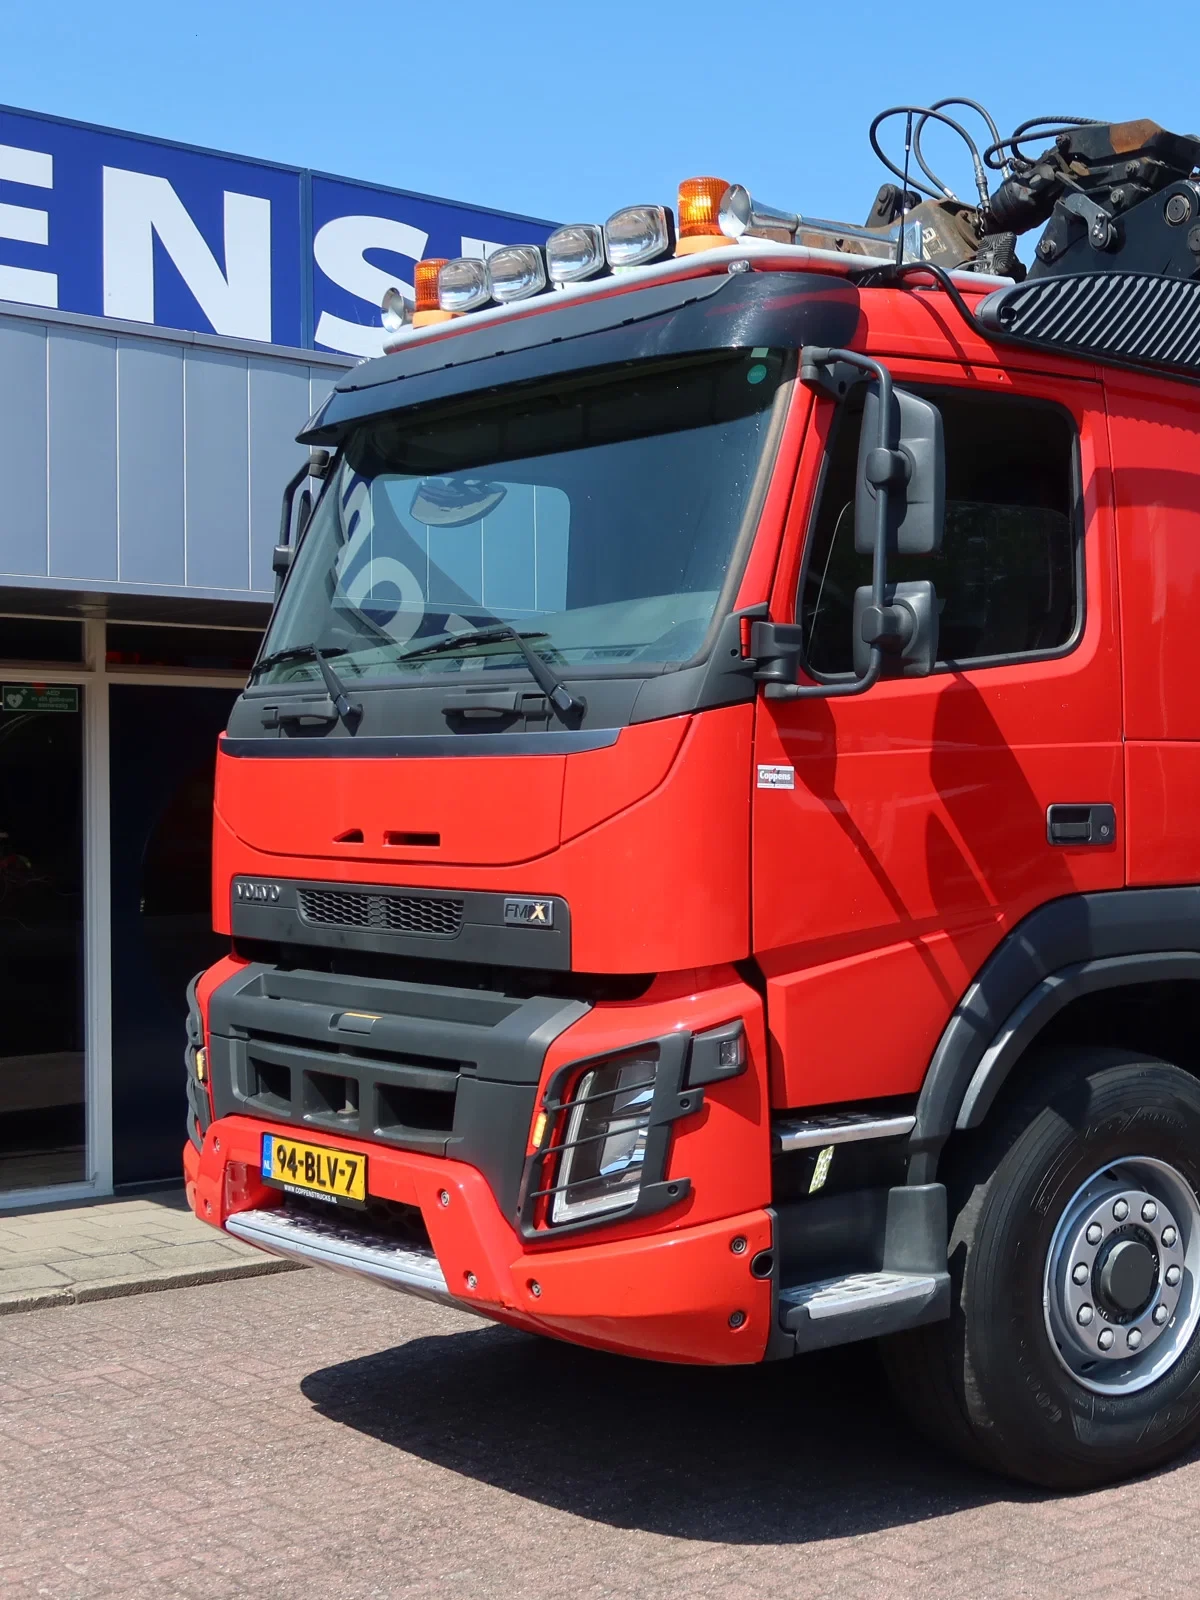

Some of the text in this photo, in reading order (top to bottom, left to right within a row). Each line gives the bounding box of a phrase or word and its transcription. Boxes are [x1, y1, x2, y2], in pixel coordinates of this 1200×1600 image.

[759, 770, 791, 782] Coppens
[235, 882, 280, 901] VOLVO
[263, 1160, 271, 1170] NL
[276, 1143, 358, 1195] 94-BLV-7
[283, 1184, 338, 1204] WWW.COPPENSTRUCKS.NL
